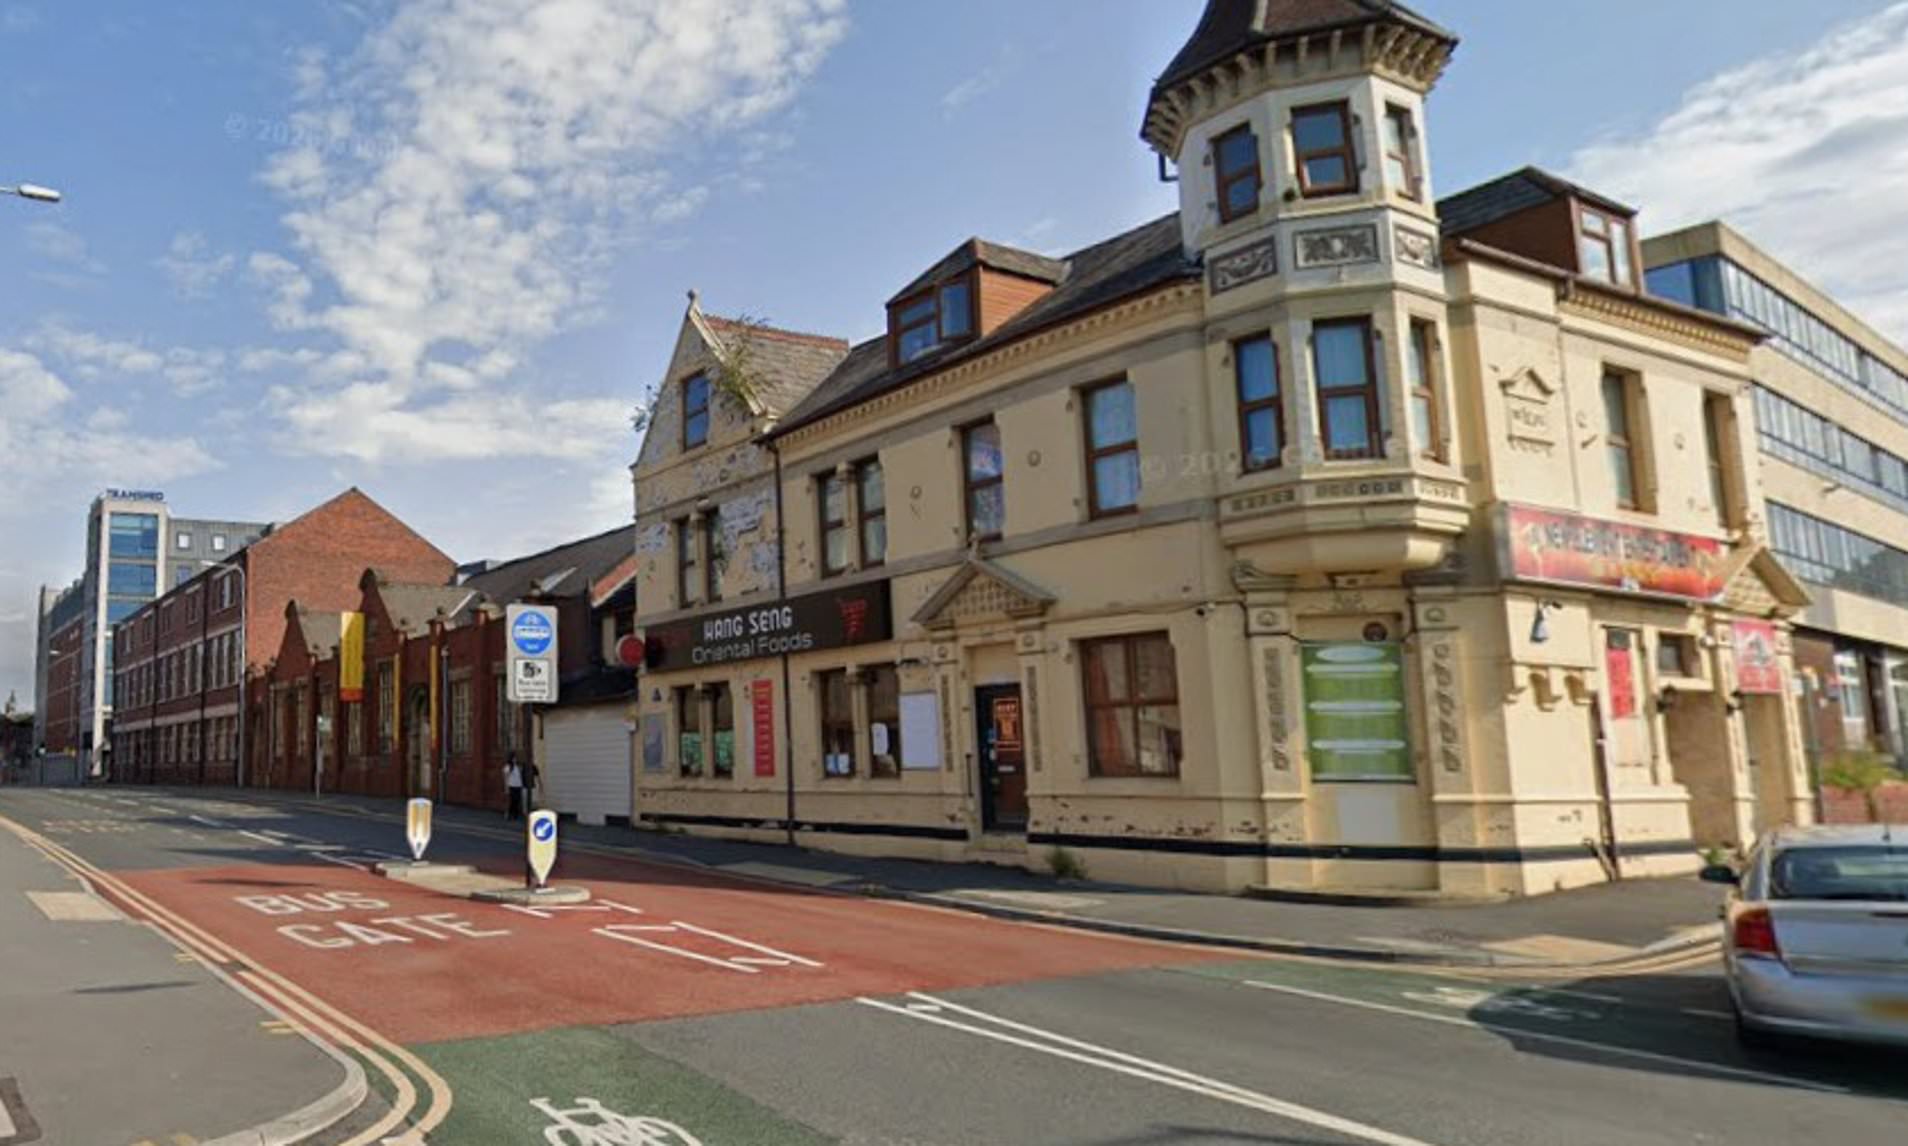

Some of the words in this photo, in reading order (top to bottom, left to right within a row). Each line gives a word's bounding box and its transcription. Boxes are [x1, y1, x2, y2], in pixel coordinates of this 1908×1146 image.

[703, 614, 744, 641] HANG
[748, 605, 793, 635] SENG
[691, 637, 755, 664] Oriental
[757, 631, 814, 654] Foods
[233, 890, 391, 916] BUS
[275, 912, 513, 949] GATE
